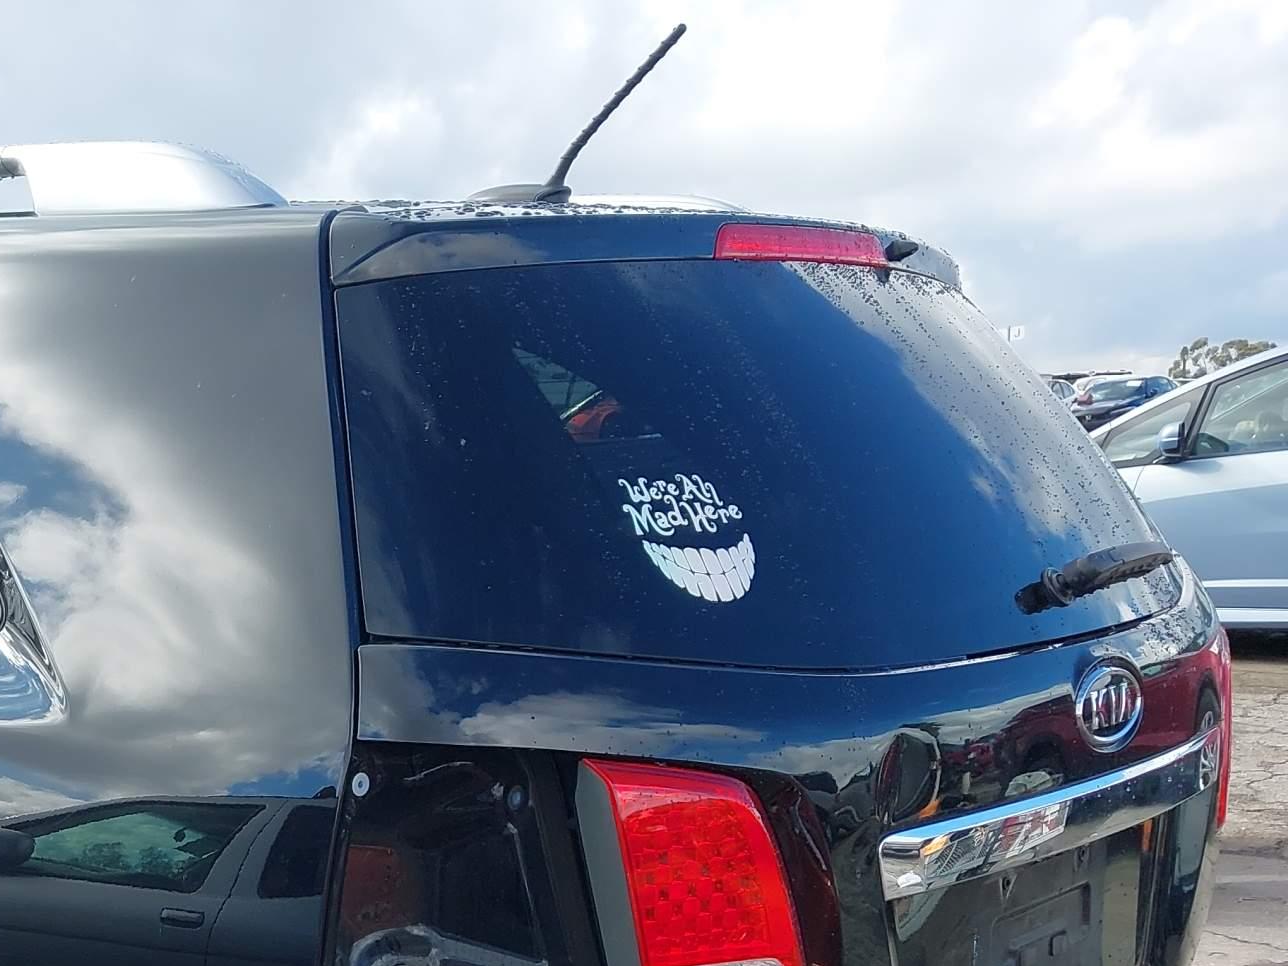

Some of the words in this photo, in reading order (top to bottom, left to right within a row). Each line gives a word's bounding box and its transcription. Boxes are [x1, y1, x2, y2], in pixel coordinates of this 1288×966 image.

[674, 473, 724, 506] All
[622, 494, 688, 536] Mad
[679, 501, 743, 533] Here
